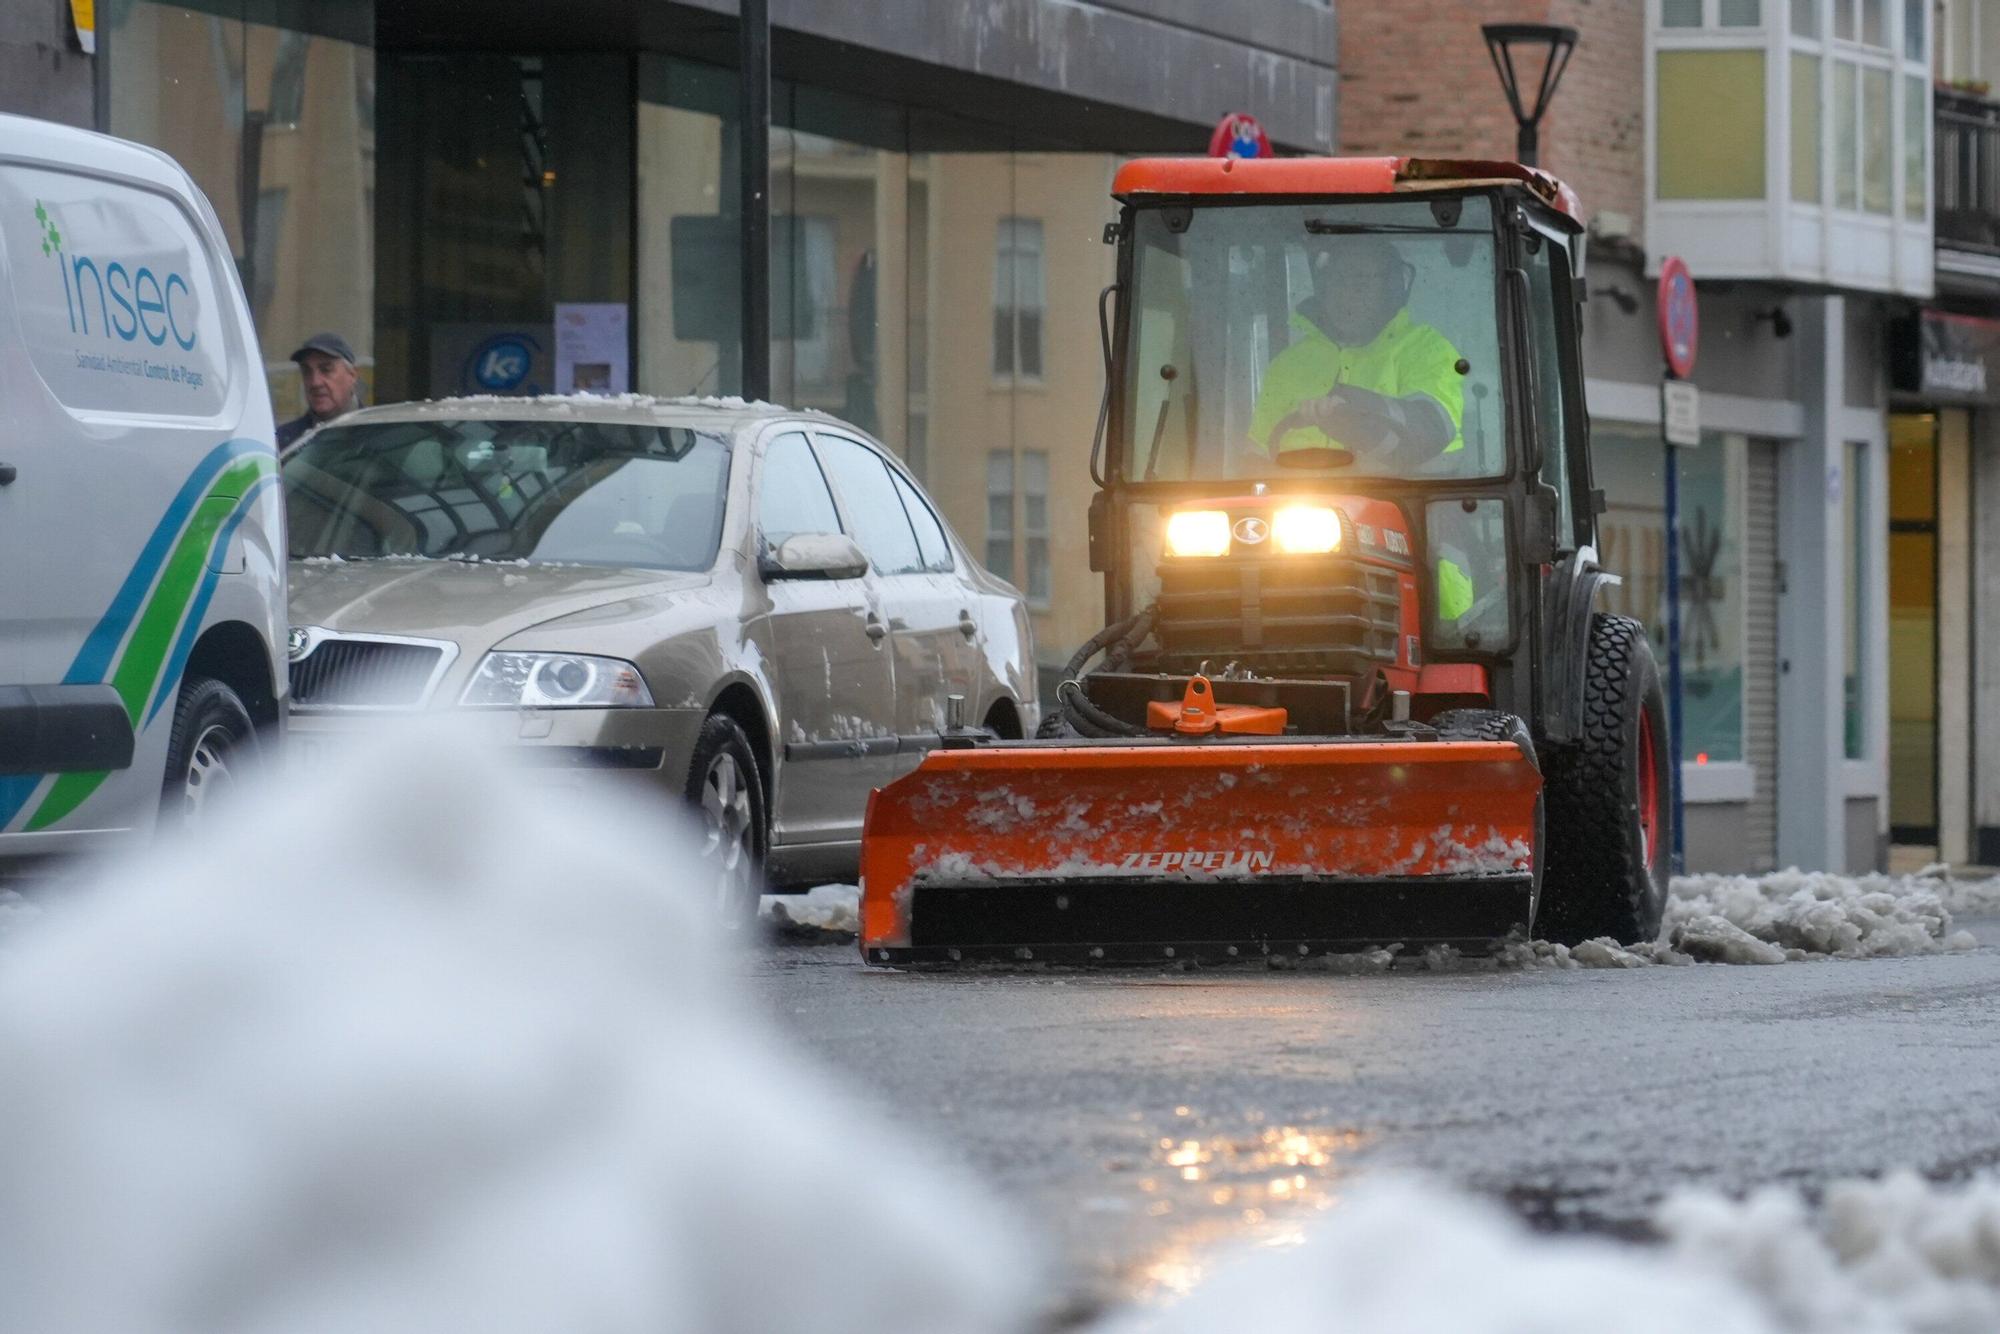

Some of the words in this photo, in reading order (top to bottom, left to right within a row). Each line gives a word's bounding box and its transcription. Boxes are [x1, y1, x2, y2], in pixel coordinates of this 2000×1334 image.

[59, 252, 196, 351] insec
[144, 360, 170, 382] Control
[171, 364, 180, 383] de
[180, 365, 203, 390] Plagas
[1118, 851, 1274, 871] ZEPPELIN
